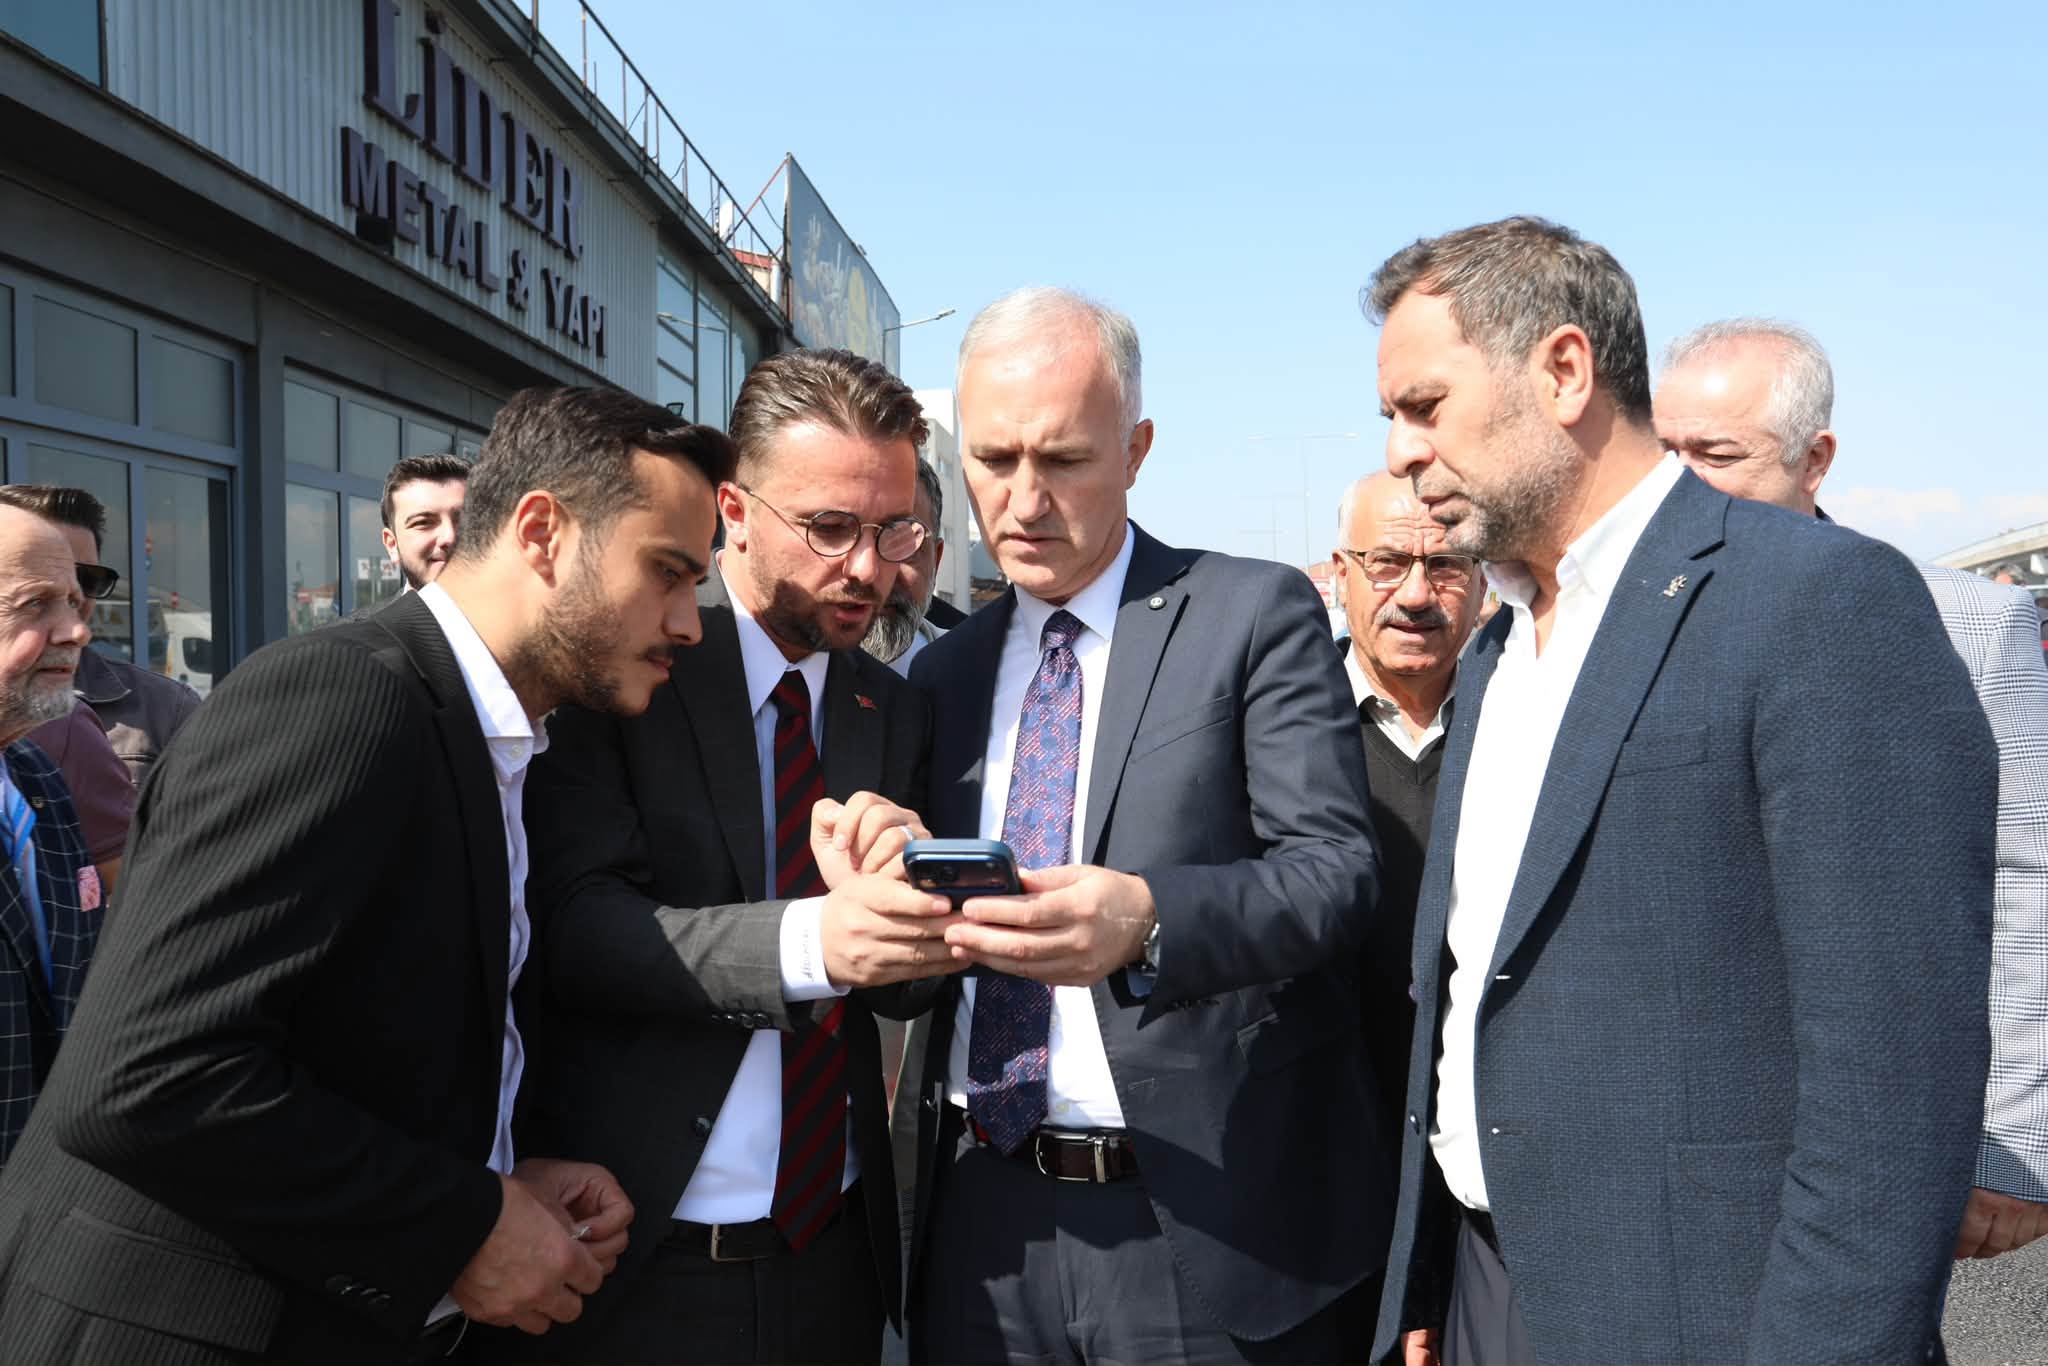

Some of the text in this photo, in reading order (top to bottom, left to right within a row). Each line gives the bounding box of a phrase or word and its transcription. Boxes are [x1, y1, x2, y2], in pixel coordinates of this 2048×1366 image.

[341, 126, 608, 359] METAL & YAPI
